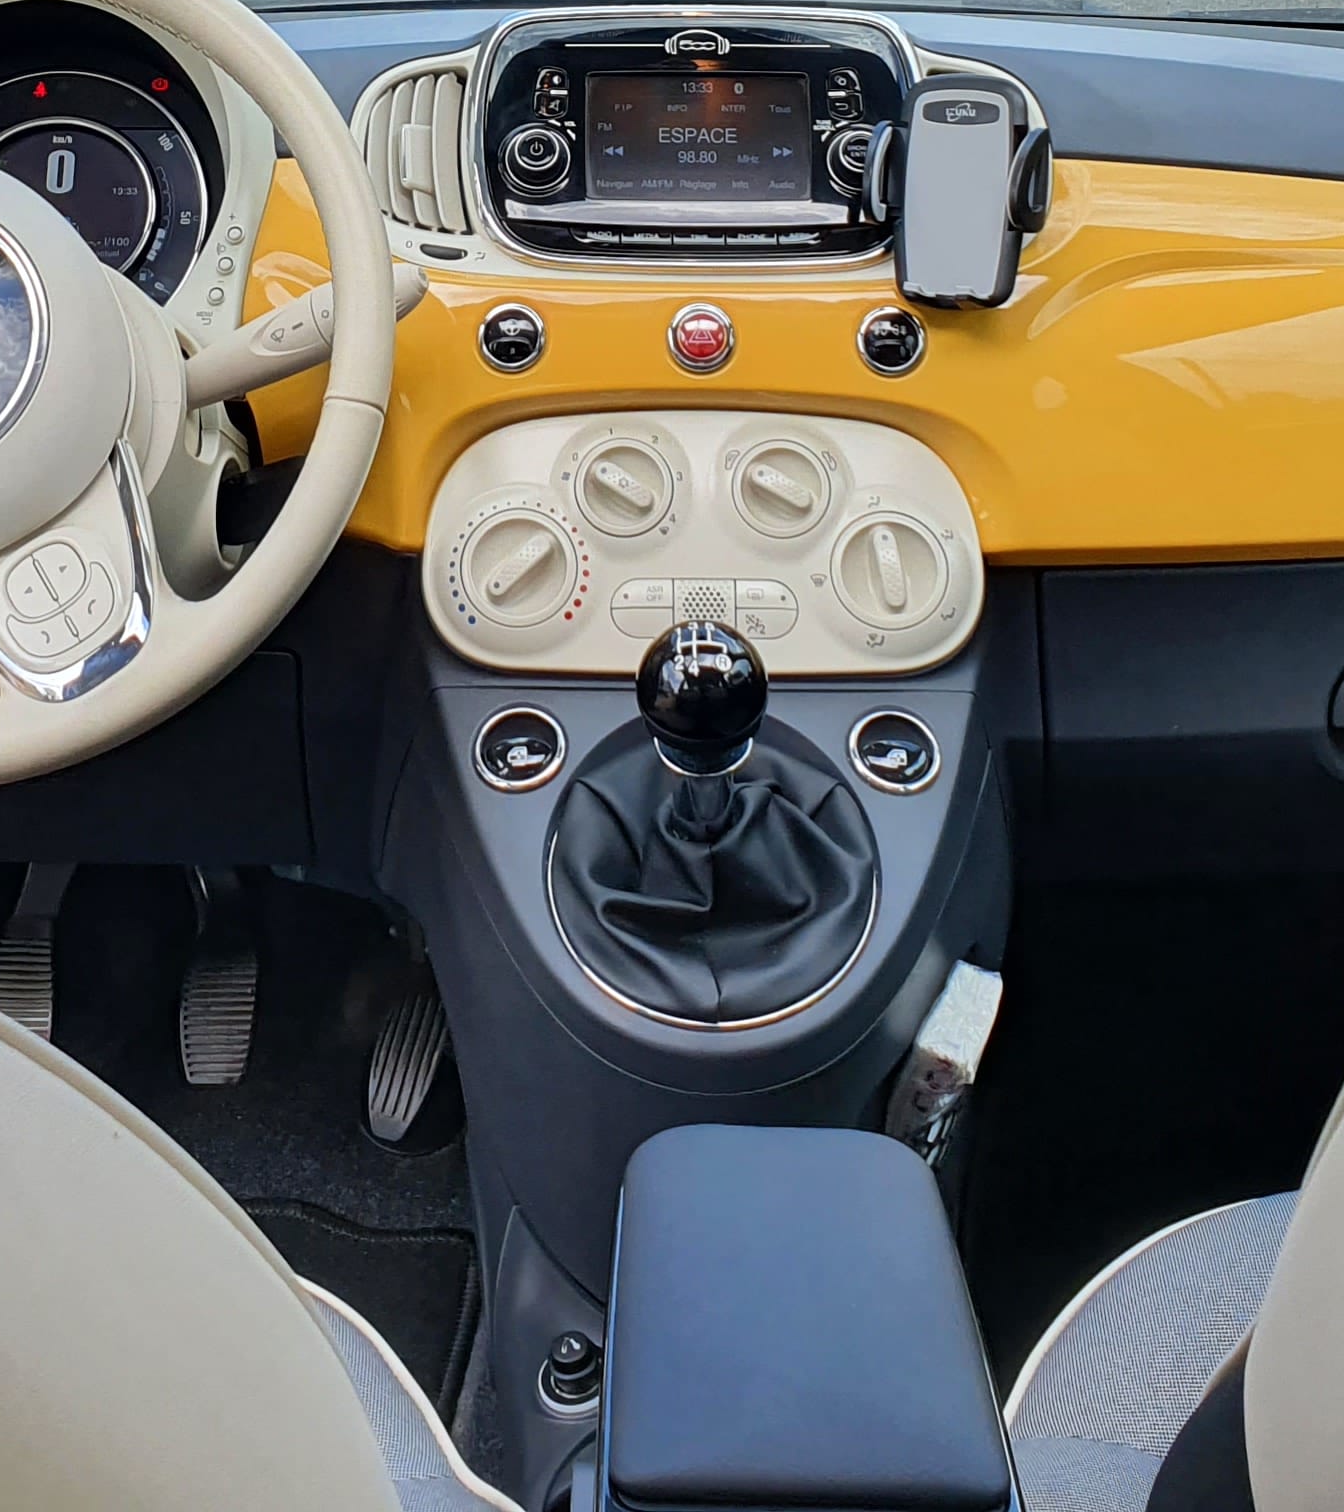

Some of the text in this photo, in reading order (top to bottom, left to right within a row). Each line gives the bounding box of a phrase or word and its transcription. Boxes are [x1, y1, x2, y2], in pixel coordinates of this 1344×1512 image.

[682, 82, 713, 94] 13:33
[52, 135, 73, 144] km/h
[157, 133, 174, 152] 100
[658, 127, 738, 144] ESPACE
[678, 150, 718, 164] 98.80
[46, 149, 76, 194] 0
[180, 211, 192, 225] 50
[651, 434, 659, 444] 2
[675, 471, 683, 481] 3
[668, 513, 676, 523] 4
[646, 594, 663, 602] OFF
[673, 654, 685, 670] 2
[687, 659, 699, 678] 4
